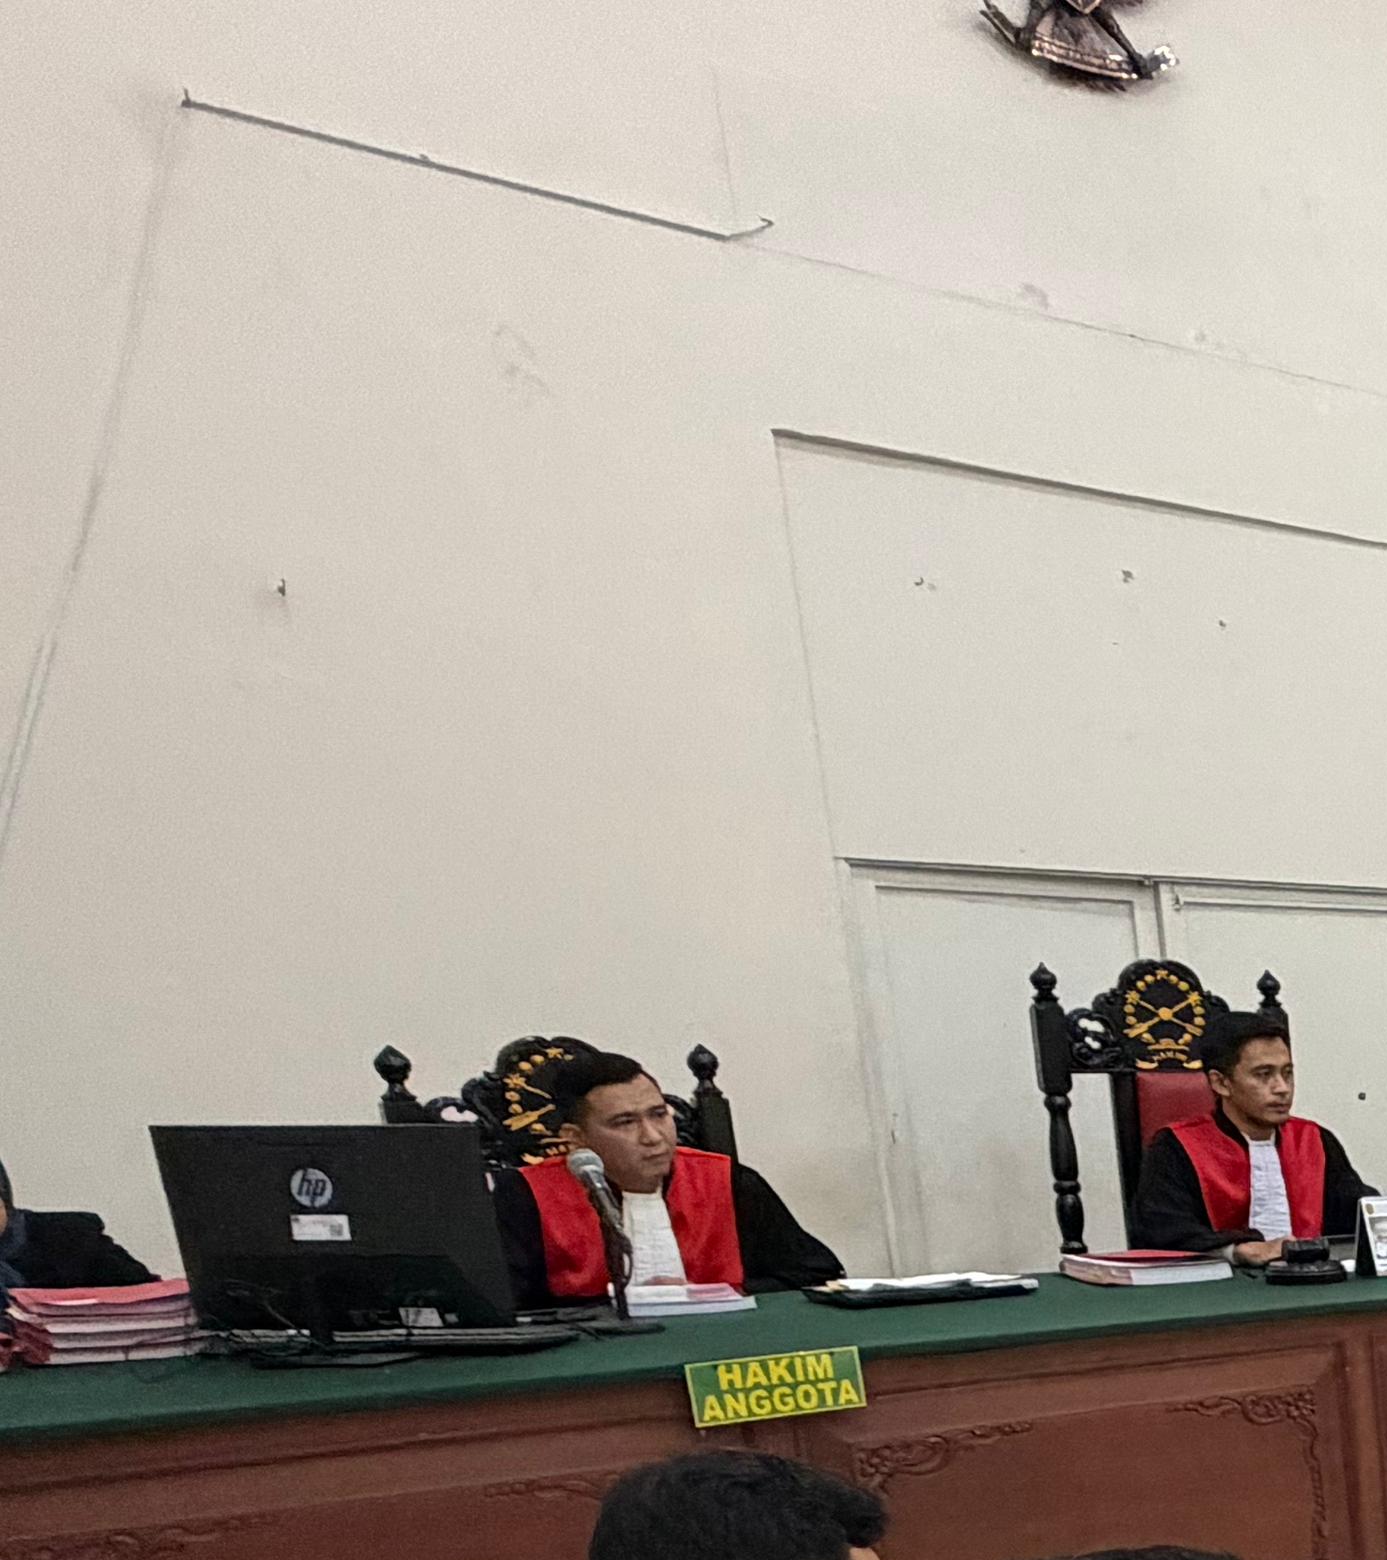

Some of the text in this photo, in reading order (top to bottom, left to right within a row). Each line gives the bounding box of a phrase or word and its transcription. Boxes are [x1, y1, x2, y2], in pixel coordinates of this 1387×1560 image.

[295, 1167, 328, 1209] hp
[717, 1353, 834, 1391] HAKIM
[703, 1379, 860, 1421] ANGGOTA
